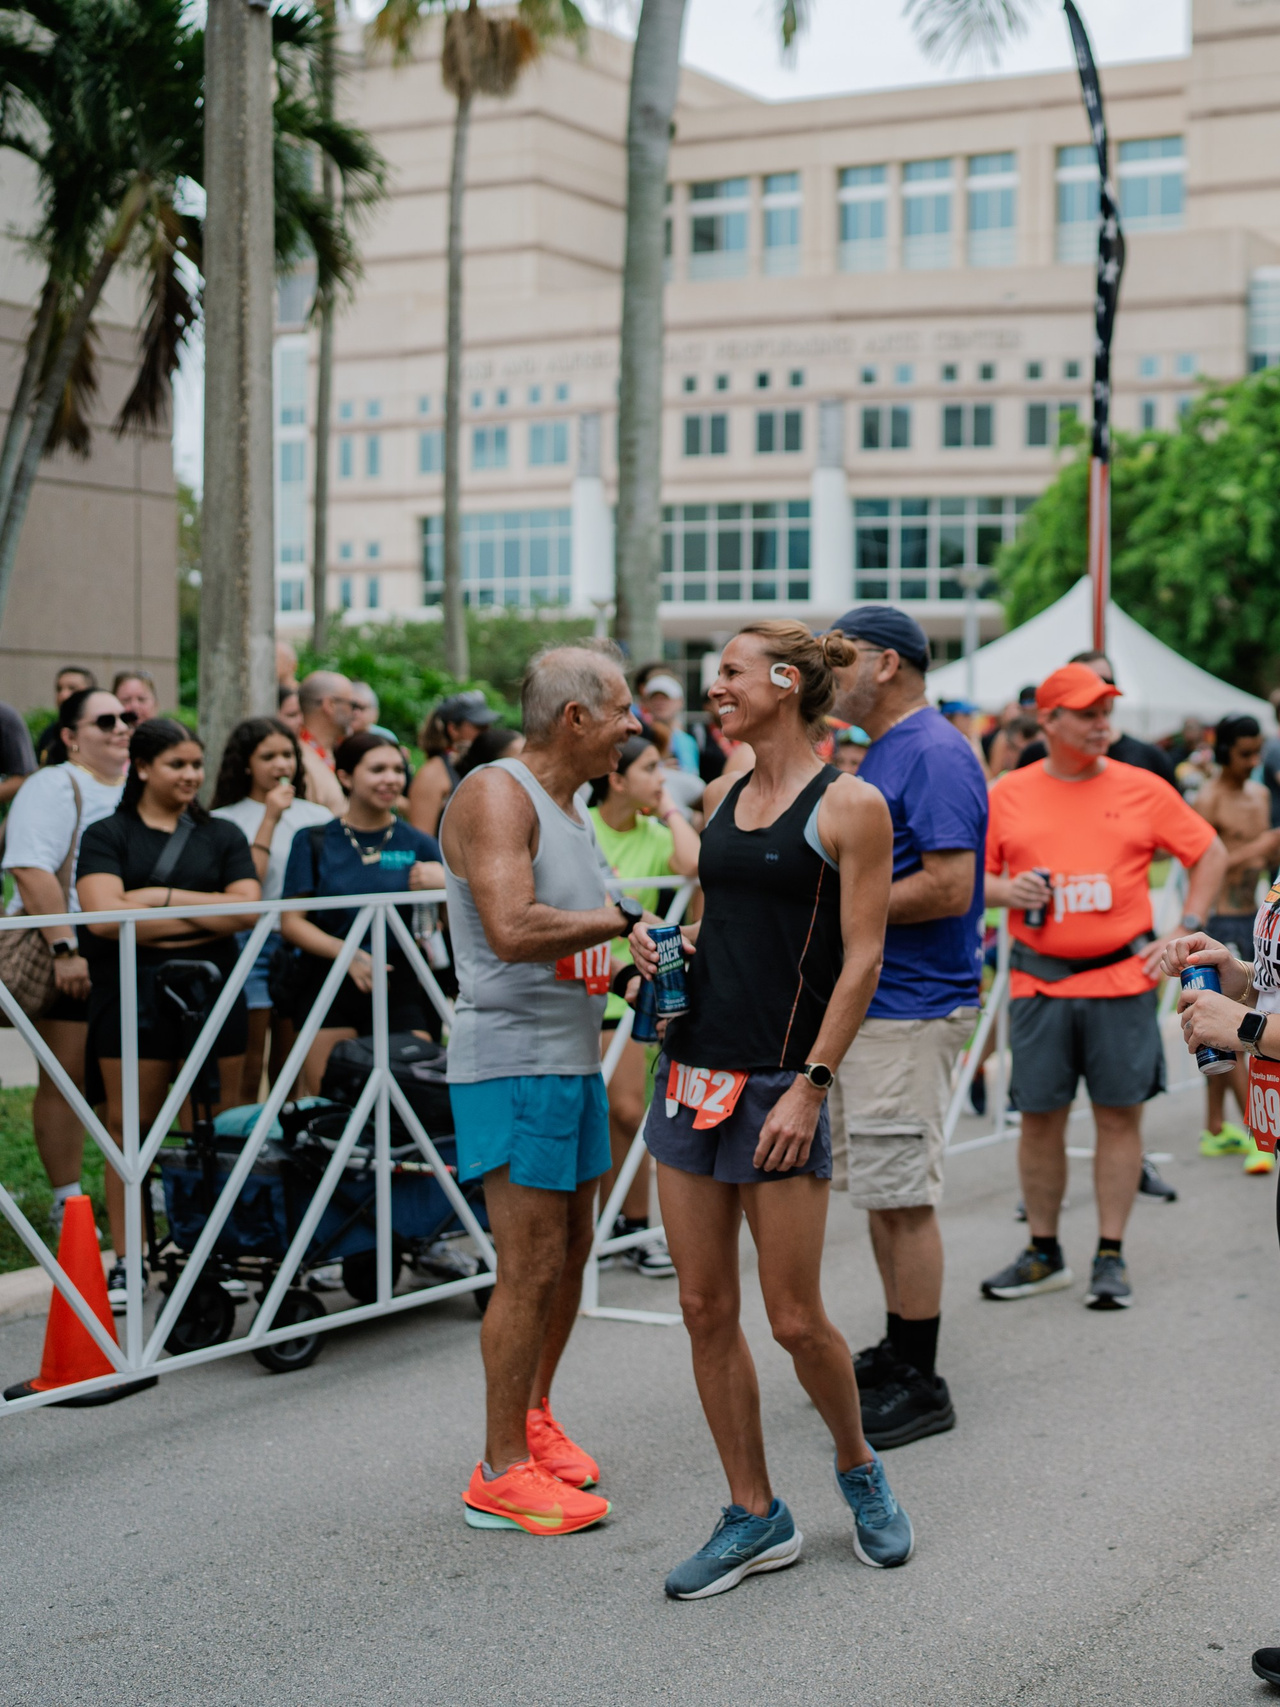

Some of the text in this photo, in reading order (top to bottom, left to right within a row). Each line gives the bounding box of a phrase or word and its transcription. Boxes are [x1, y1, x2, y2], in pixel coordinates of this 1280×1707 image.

[657, 934, 682, 953] AYMAN
[658, 947, 681, 966] JACK
[676, 1063, 736, 1114] 1162
